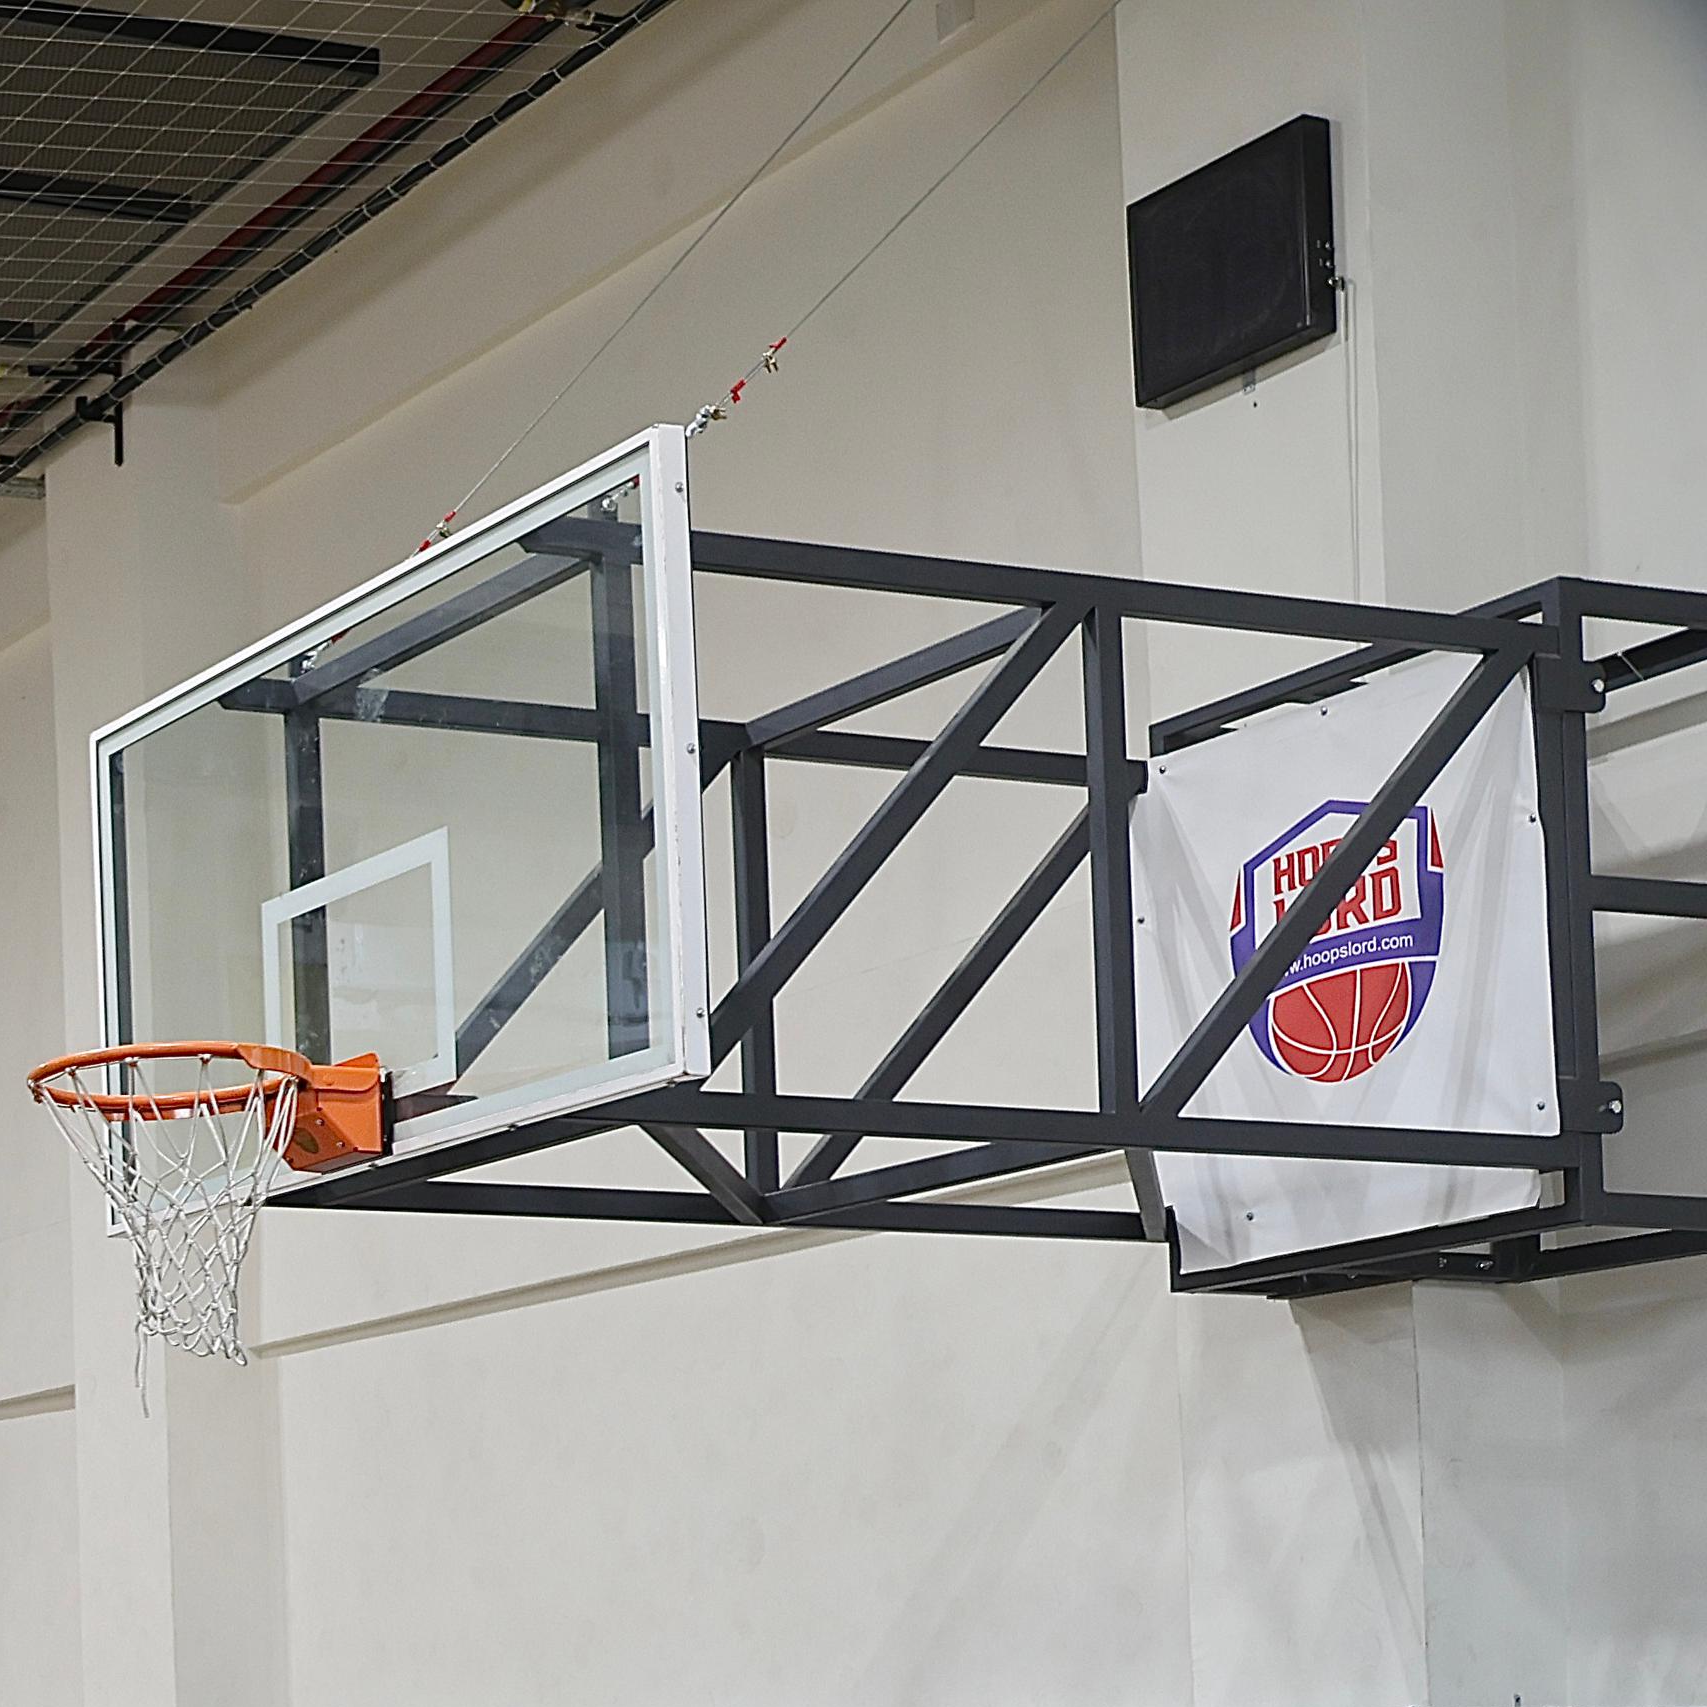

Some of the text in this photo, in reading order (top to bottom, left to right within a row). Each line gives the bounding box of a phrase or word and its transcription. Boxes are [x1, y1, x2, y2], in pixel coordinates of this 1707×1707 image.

[1272, 836, 1398, 896] HOS
[1273, 865, 1403, 936] RD
[1284, 934, 1414, 978] w.hoopslord.com
